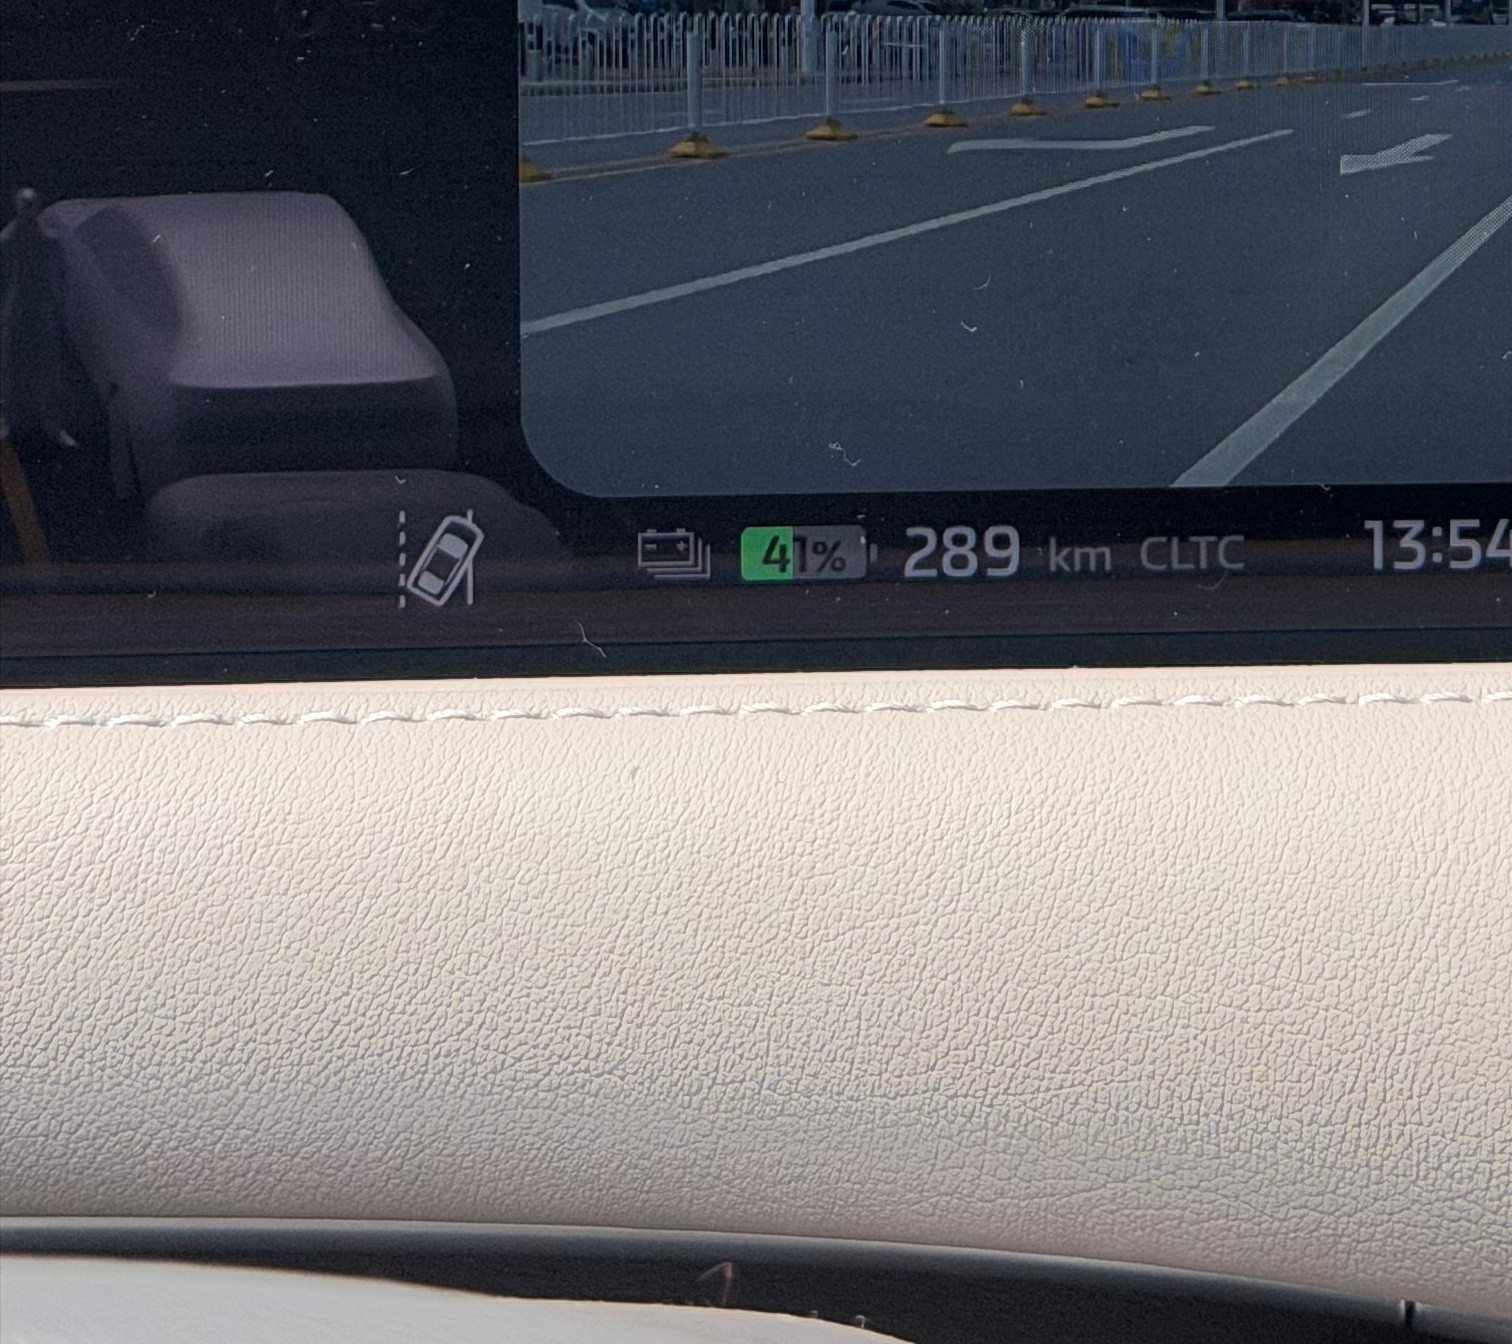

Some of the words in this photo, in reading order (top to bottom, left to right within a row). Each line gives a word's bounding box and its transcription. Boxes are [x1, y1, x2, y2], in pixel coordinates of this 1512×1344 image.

[762, 534, 846, 573] 41%
[902, 524, 1021, 578] 289
[1049, 528, 1112, 573] km
[1140, 534, 1246, 571] CLTC
